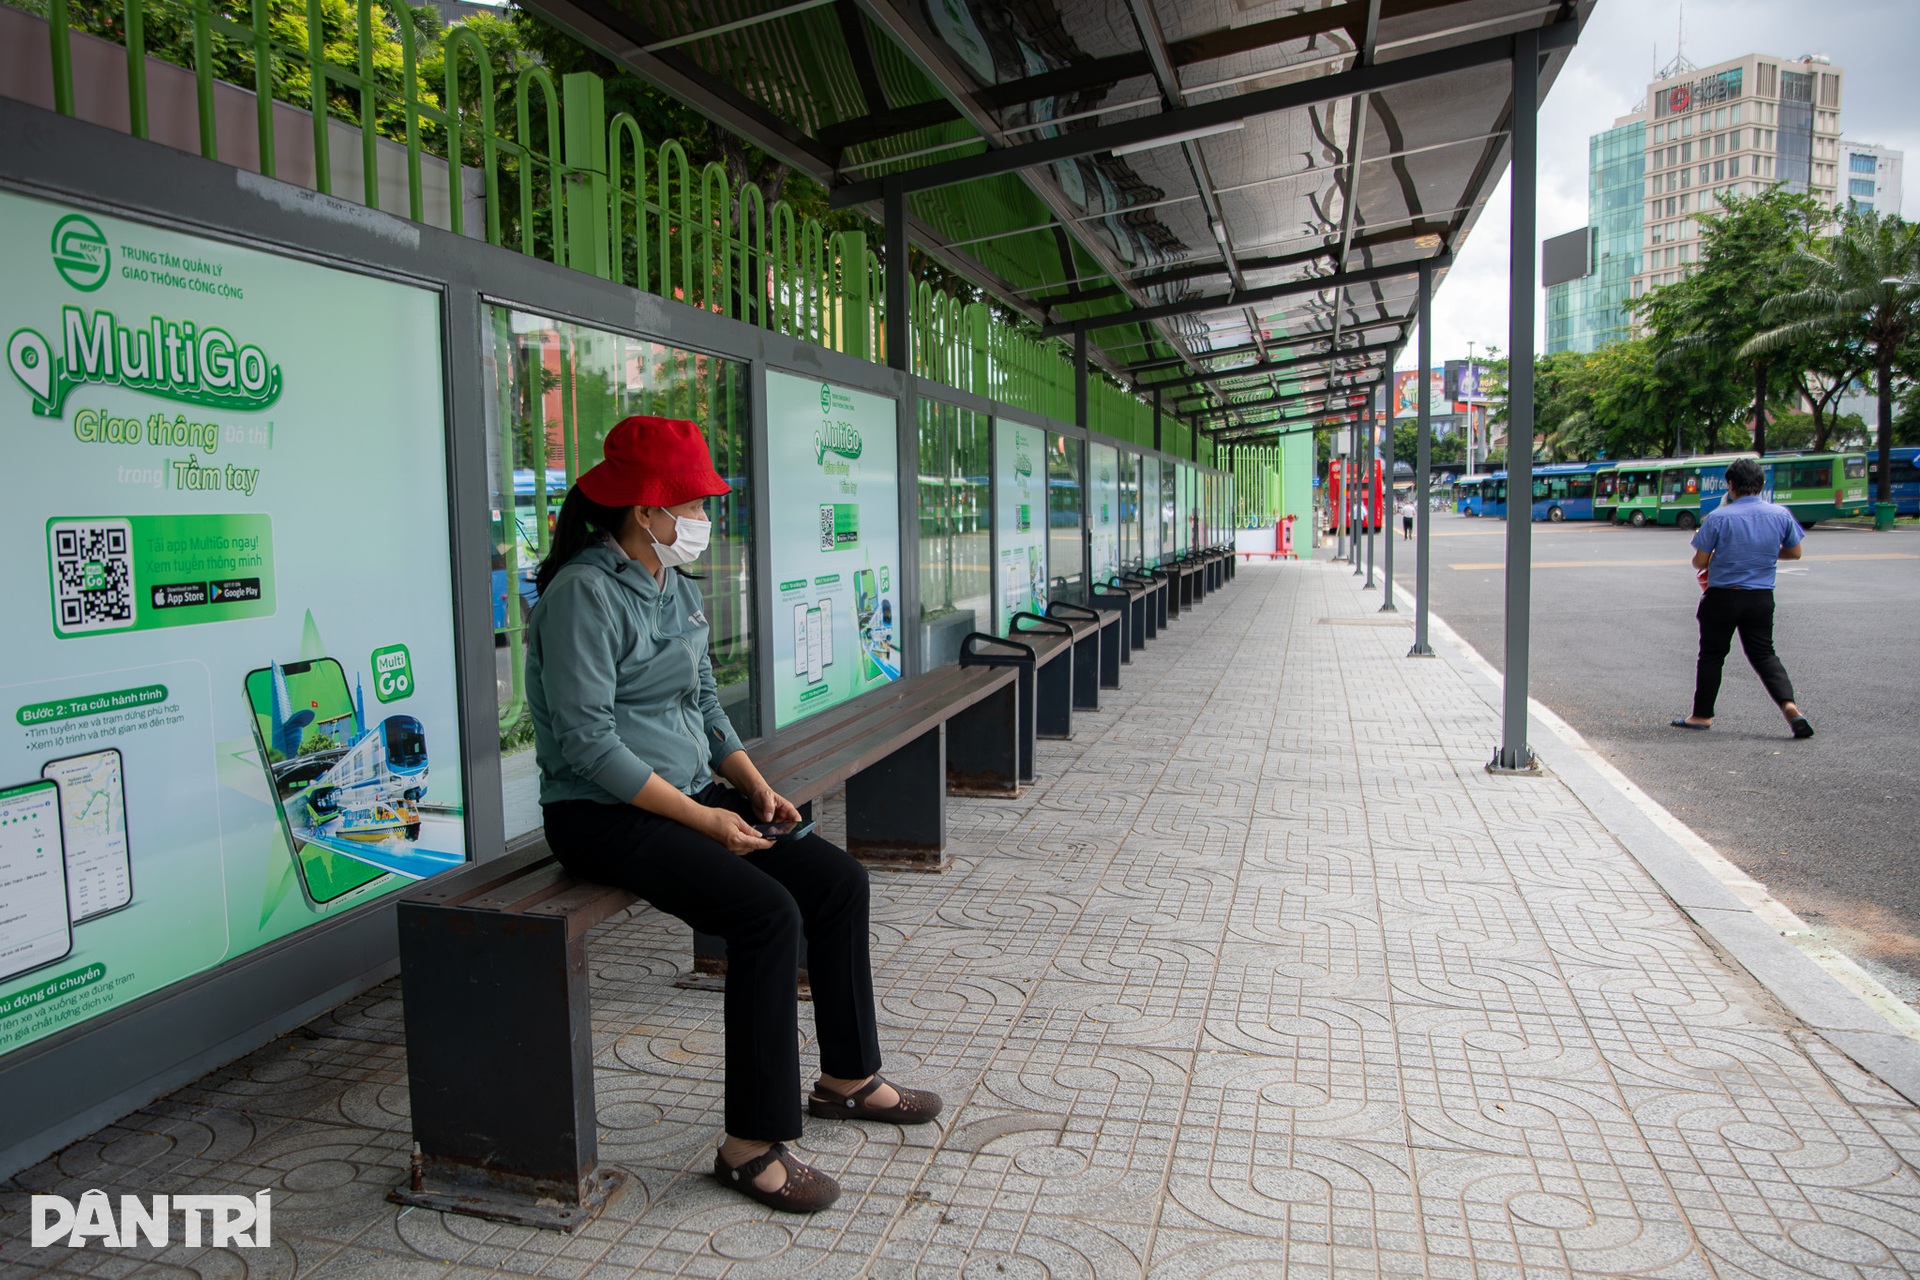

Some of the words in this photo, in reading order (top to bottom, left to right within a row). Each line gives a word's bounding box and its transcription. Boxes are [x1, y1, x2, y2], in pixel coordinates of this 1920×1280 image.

[120, 245, 157, 264] TRUNG
[159, 253, 180, 269] TÂM
[182, 258, 211, 274] QUẢN
[212, 263, 223, 277] LÝ
[121, 266, 149, 282] GIAO
[150, 271, 187, 289] THÔNG
[188, 279, 216, 294] CÔNG
[217, 285, 244, 300] CỘNG
[62, 305, 269, 395] MultiGo
[74, 409, 142, 444] Giao
[147, 413, 219, 454] thông
[117, 465, 164, 488] trong
[173, 454, 221, 490] Tầm
[226, 463, 259, 496] tay
[167, 541, 188, 554] app
[190, 536, 230, 550] MultiGo
[232, 536, 259, 552] ngay!
[146, 560, 171, 573] Xem
[174, 554, 205, 575] tuyến
[207, 556, 236, 571] thông
[238, 554, 262, 568] minh
[87, 575, 103, 587] Go
[224, 587, 245, 599] Google
[245, 586, 259, 597] Play
[167, 593, 183, 605] App
[185, 592, 204, 602] Store
[379, 653, 404, 670] Multi
[380, 672, 408, 695] Go
[23, 708, 54, 721] Bước
[56, 705, 68, 715] 2:
[70, 703, 88, 713] Tra
[89, 697, 110, 709] cứu
[111, 693, 138, 706] hành
[139, 689, 162, 701] trình
[50, 721, 77, 735] tuyến
[77, 720, 89, 728] xe
[90, 717, 101, 726] và
[102, 714, 123, 725] trạm
[124, 709, 146, 720] dừng
[164, 704, 180, 713] hợp
[30, 740, 54, 751] Xem
[65, 733, 86, 743] trình
[87, 731, 99, 740] và
[100, 726, 117, 738] thời
[118, 724, 136, 735] gian
[137, 722, 148, 730] xe
[149, 717, 165, 728] đến
[166, 714, 184, 725] trạm
[3, 1018, 19, 1031] lên
[21, 1013, 33, 1024] xe
[34, 1007, 46, 1018] và
[48, 994, 78, 1012] xuống
[79, 989, 90, 999] xe
[91, 980, 114, 996] đúng
[115, 972, 136, 986] trạm
[14, 988, 45, 1007] động
[46, 983, 57, 995] di
[60, 967, 101, 989] chuyển
[14, 1023, 30, 1041] giá
[31, 1016, 53, 1031] chất
[54, 1005, 82, 1022] lượng
[82, 997, 101, 1011] dịch
[103, 993, 114, 1003] vụ
